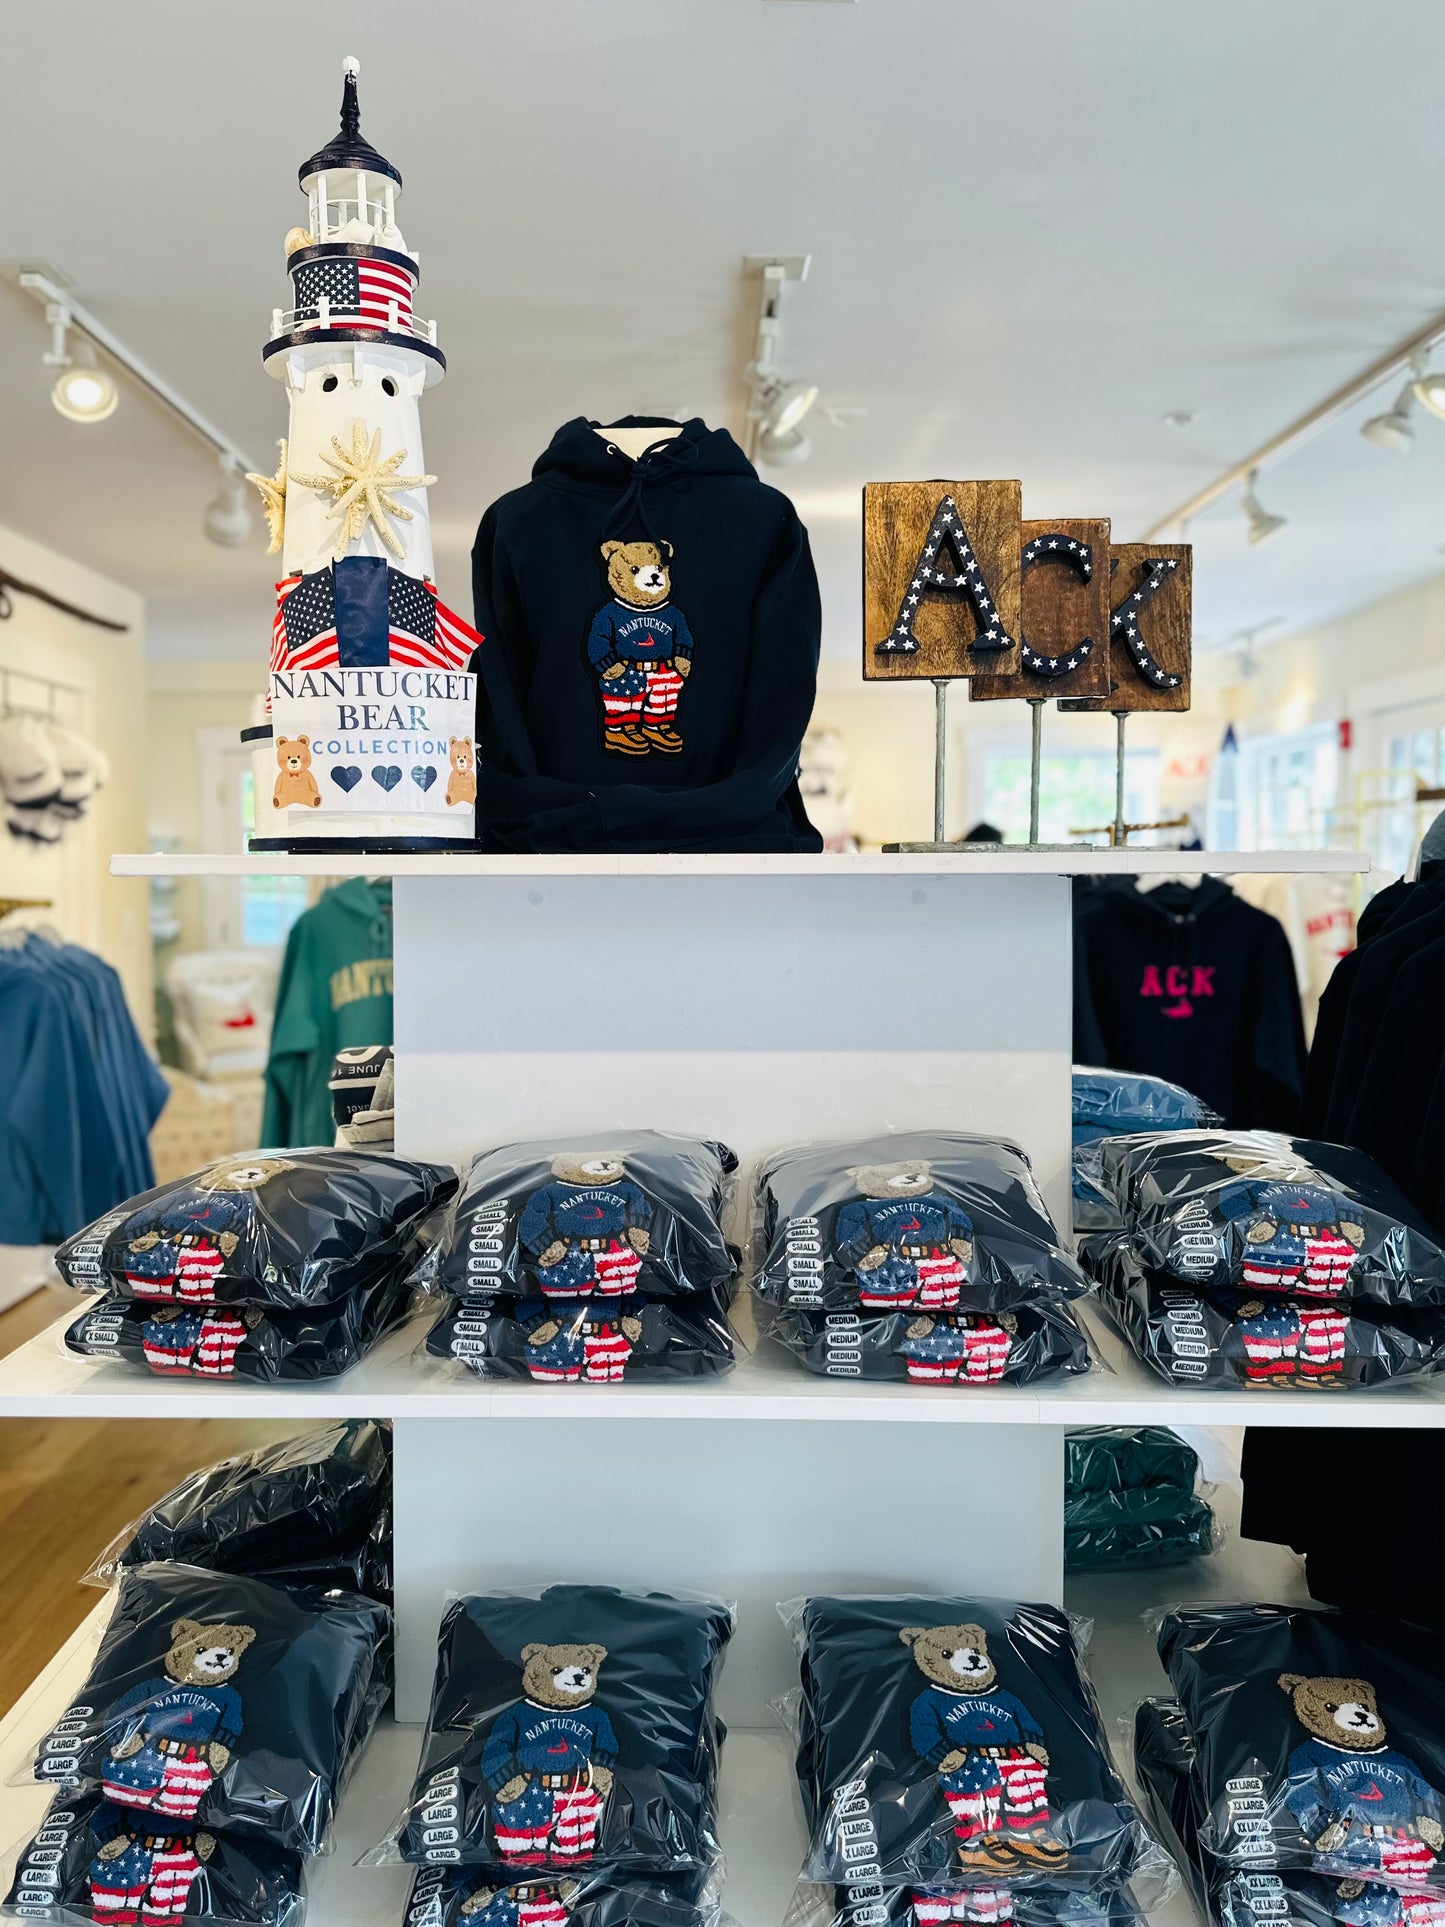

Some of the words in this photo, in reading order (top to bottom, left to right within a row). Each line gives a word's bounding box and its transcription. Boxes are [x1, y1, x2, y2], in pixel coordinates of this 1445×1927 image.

[618, 616, 673, 637] NANTUCKET
[272, 671, 474, 700] NANTUCKET
[337, 704, 430, 731] BEAR
[312, 739, 447, 755] COLLECTION
[1140, 965, 1215, 997] ACK
[348, 1064, 381, 1075] JUNE
[559, 1191, 626, 1211] NANTUCKET
[479, 1211, 502, 1220] SMALL
[874, 1202, 943, 1221] NANTUCKET
[1180, 1220, 1211, 1230] MEDIUM
[791, 1229, 815, 1237] SMALL
[474, 1241, 498, 1250] SMALL
[792, 1242, 816, 1252] SMALL
[473, 1260, 498, 1269] SMALL
[793, 1260, 817, 1270] SMALL
[1185, 1255, 1215, 1265] MEDIUM
[71, 1263, 76, 1271] X
[472, 1279, 497, 1287] SMALL
[793, 1279, 818, 1289] SMALL
[828, 1315, 858, 1326] MEDIUM
[1170, 1311, 1201, 1320] MEDIUM
[459, 1323, 482, 1333] SMALL
[1174, 1325, 1204, 1336] MEDIUM
[88, 1332, 94, 1341] X
[94, 1332, 115, 1342] SMALL
[830, 1334, 859, 1344] MEDIUM
[1177, 1343, 1206, 1355] MEDIUM
[830, 1351, 859, 1360] MEDIUM
[829, 1367, 858, 1375] MEDIUM
[1174, 1362, 1205, 1373] MEDIUM
[153, 1692, 221, 1713] NANTUCKET
[64, 1708, 89, 1718] LARGE
[946, 1700, 1013, 1723] NANTUCKET
[525, 1717, 593, 1742] NANTUCKET
[51, 1739, 77, 1750] LARGE
[433, 1769, 455, 1782] LARGE
[1327, 1760, 1404, 1785] NANTUCKET
[1229, 1782, 1239, 1790] XX
[1240, 1780, 1260, 1790] LARGE
[429, 1786, 453, 1799] LARGE
[1233, 1802, 1242, 1811] XX
[1243, 1801, 1264, 1810] LARGE
[48, 1814, 71, 1824] LARGE
[428, 1808, 453, 1820] LARGE
[847, 1821, 871, 1835] LARGE
[1237, 1822, 1247, 1833] XX
[40, 1832, 64, 1842] LARGE
[428, 1830, 454, 1842] LARGE
[33, 1852, 58, 1862] LARGE
[430, 1850, 456, 1858] LARGE
[845, 1848, 851, 1859] X
[851, 1844, 875, 1858] LARGE
[848, 1870, 854, 1878] X
[855, 1866, 877, 1878] LARGE
[1250, 1877, 1259, 1888] XX
[1260, 1877, 1281, 1888] LARGE
[416, 1884, 439, 1901] LARGE
[851, 1889, 858, 1900] X
[858, 1885, 881, 1899] LARGE
[1254, 1900, 1263, 1910] XX
[1263, 1900, 1286, 1910] LARGE
[21, 1908, 46, 1916] LARGE
[856, 1911, 862, 1921] X
